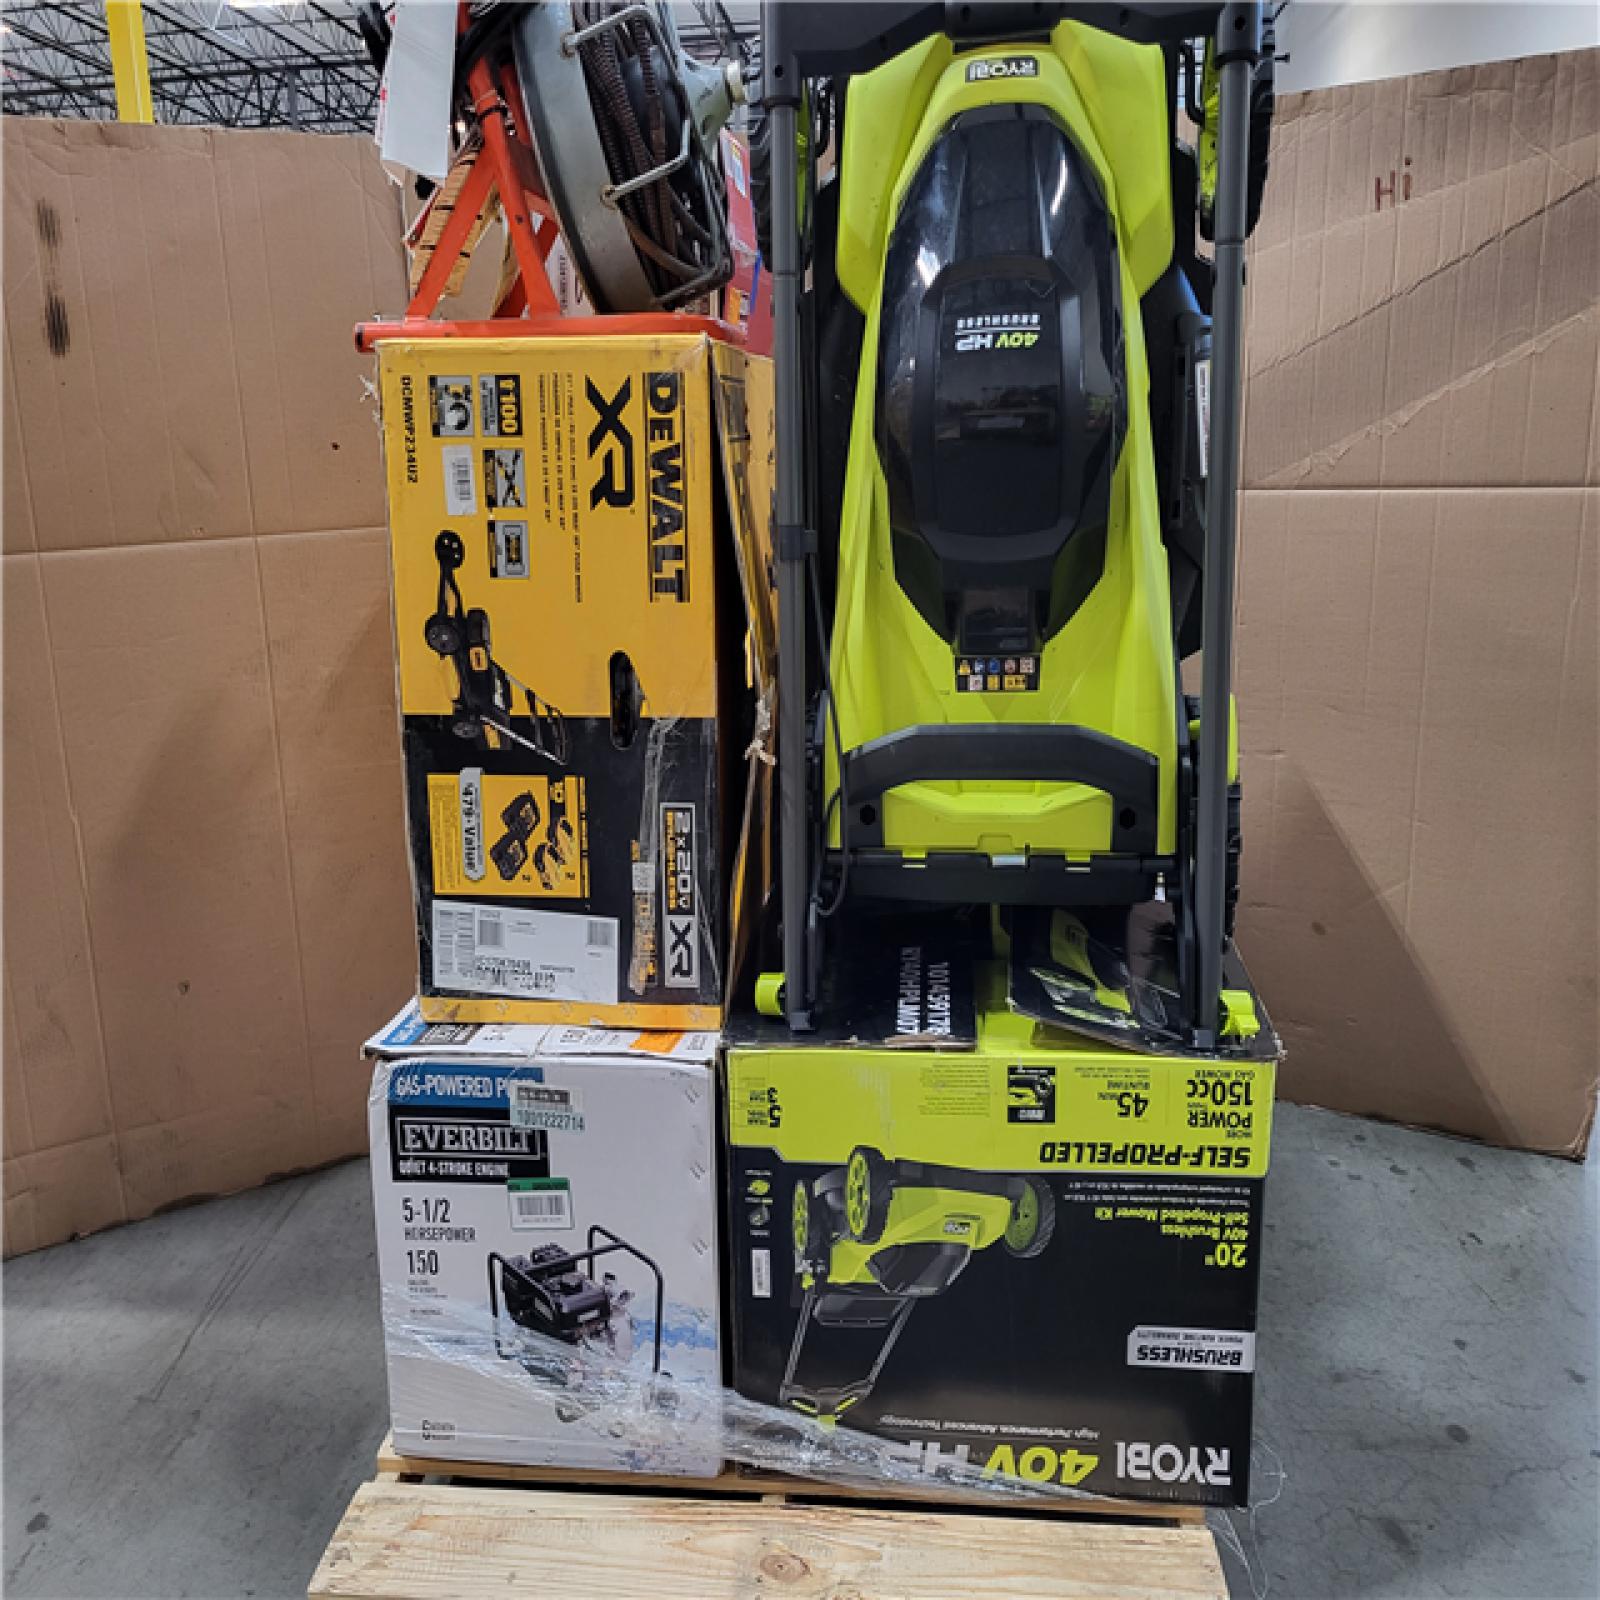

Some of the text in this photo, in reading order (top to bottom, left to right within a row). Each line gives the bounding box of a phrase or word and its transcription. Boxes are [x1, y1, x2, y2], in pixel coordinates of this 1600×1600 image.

[1375, 157, 1413, 213] Hi
[954, 332, 1040, 351] 40V HP
[586, 374, 635, 511] XR
[397, 1075, 493, 1098] GAS-POWERED
[1187, 1079, 1254, 1106] 150cc
[1117, 1092, 1150, 1118] 45
[1187, 1109, 1253, 1128] POWER
[403, 1125, 532, 1150] EVERBILT
[1040, 1142, 1250, 1167] SELF-PROPELLED
[402, 1196, 451, 1224] 5-1/2
[404, 1226, 477, 1242] HORSEPOWER
[406, 1249, 440, 1276] 150
[1137, 1345, 1243, 1366] BRUSHLESS
[980, 1444, 1099, 1486] 40V
[1116, 1442, 1231, 1485] RYOBI
